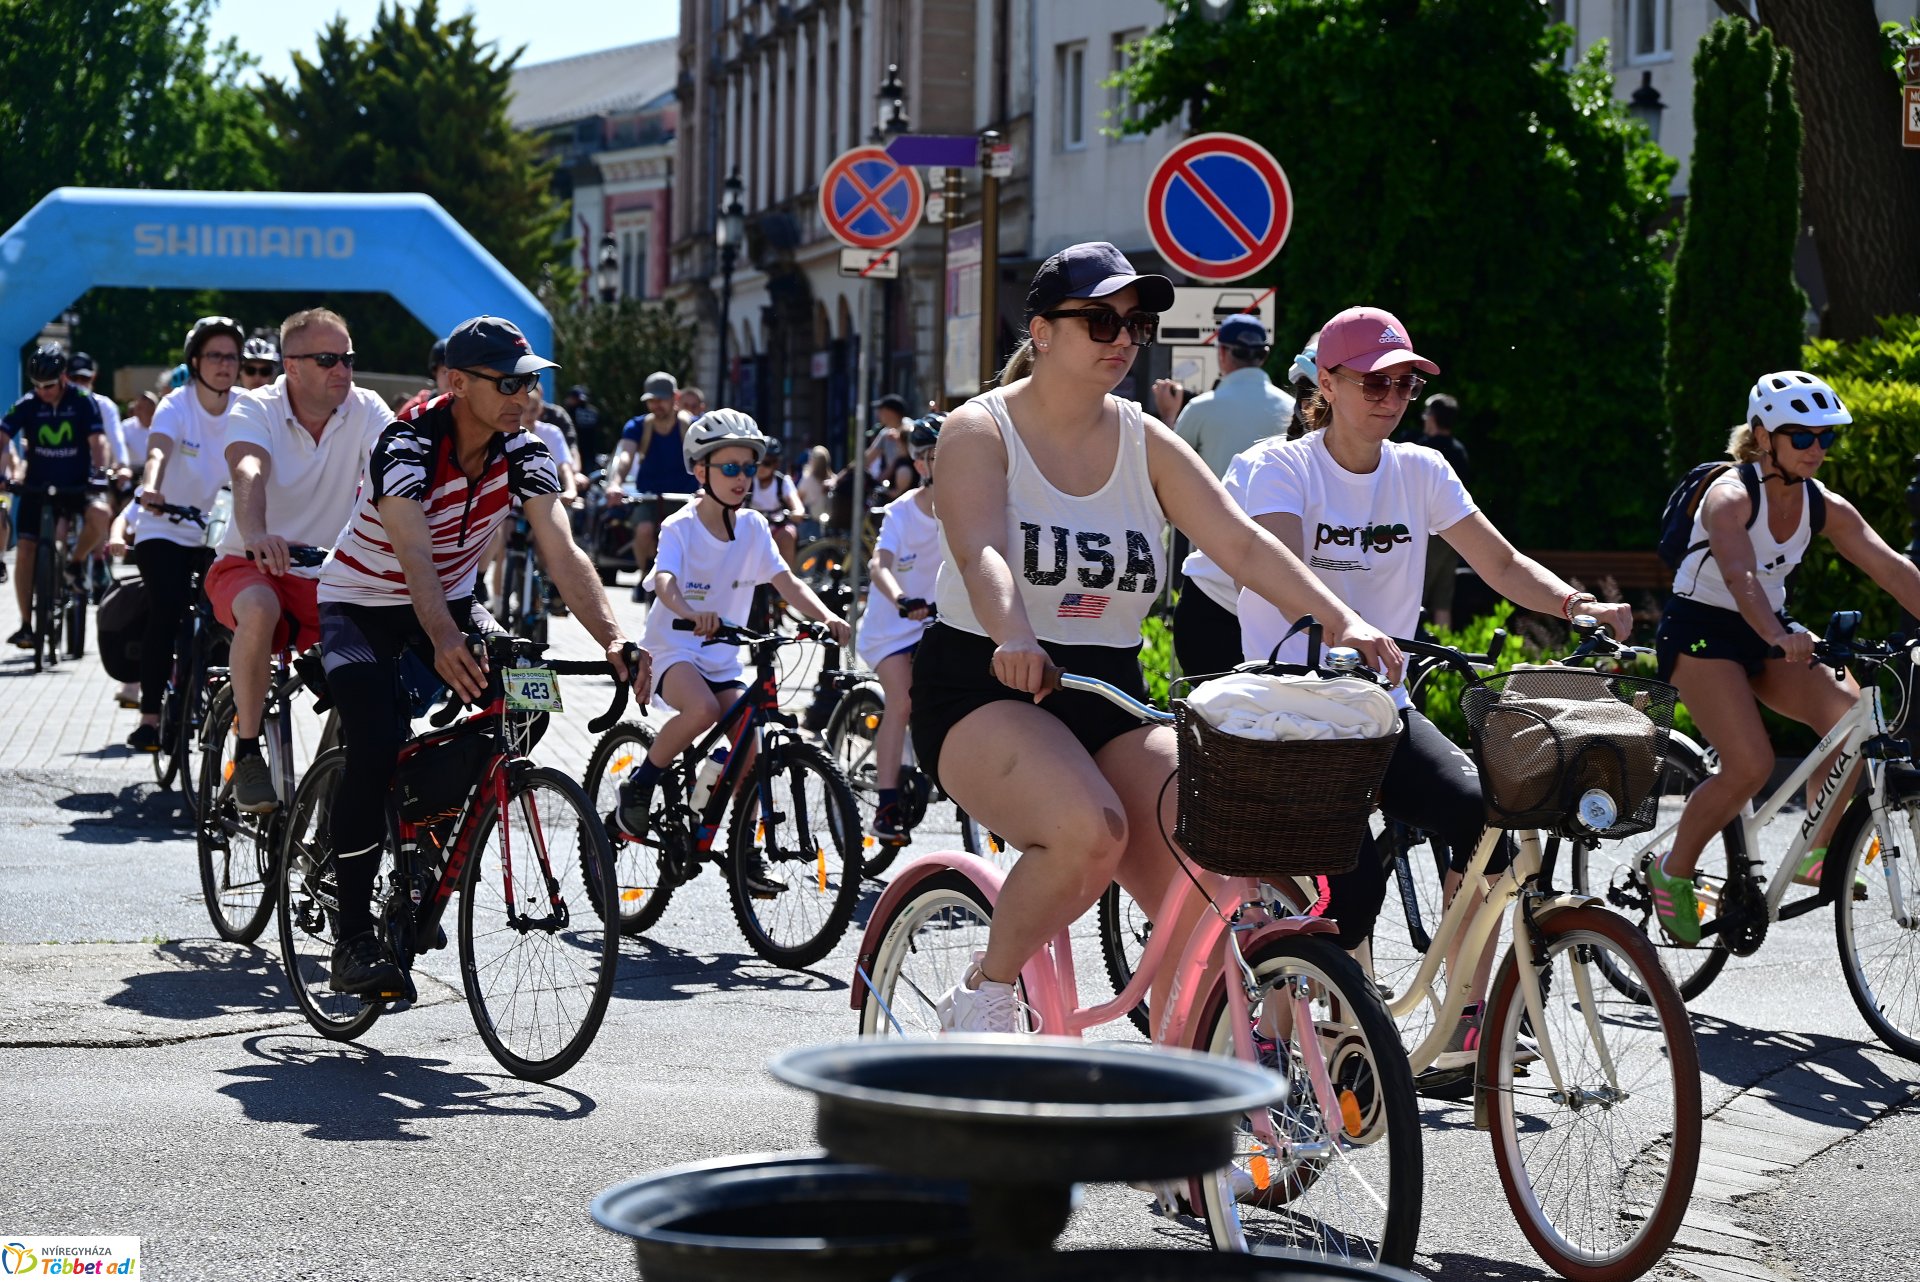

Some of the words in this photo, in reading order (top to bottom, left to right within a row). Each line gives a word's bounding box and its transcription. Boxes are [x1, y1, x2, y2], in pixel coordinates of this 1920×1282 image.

[134, 223, 355, 259] SHIMANO
[35, 447, 78, 458] movistar
[1020, 521, 1157, 593] USA
[521, 682, 550, 700] 423
[1801, 751, 1852, 840] ALPINA
